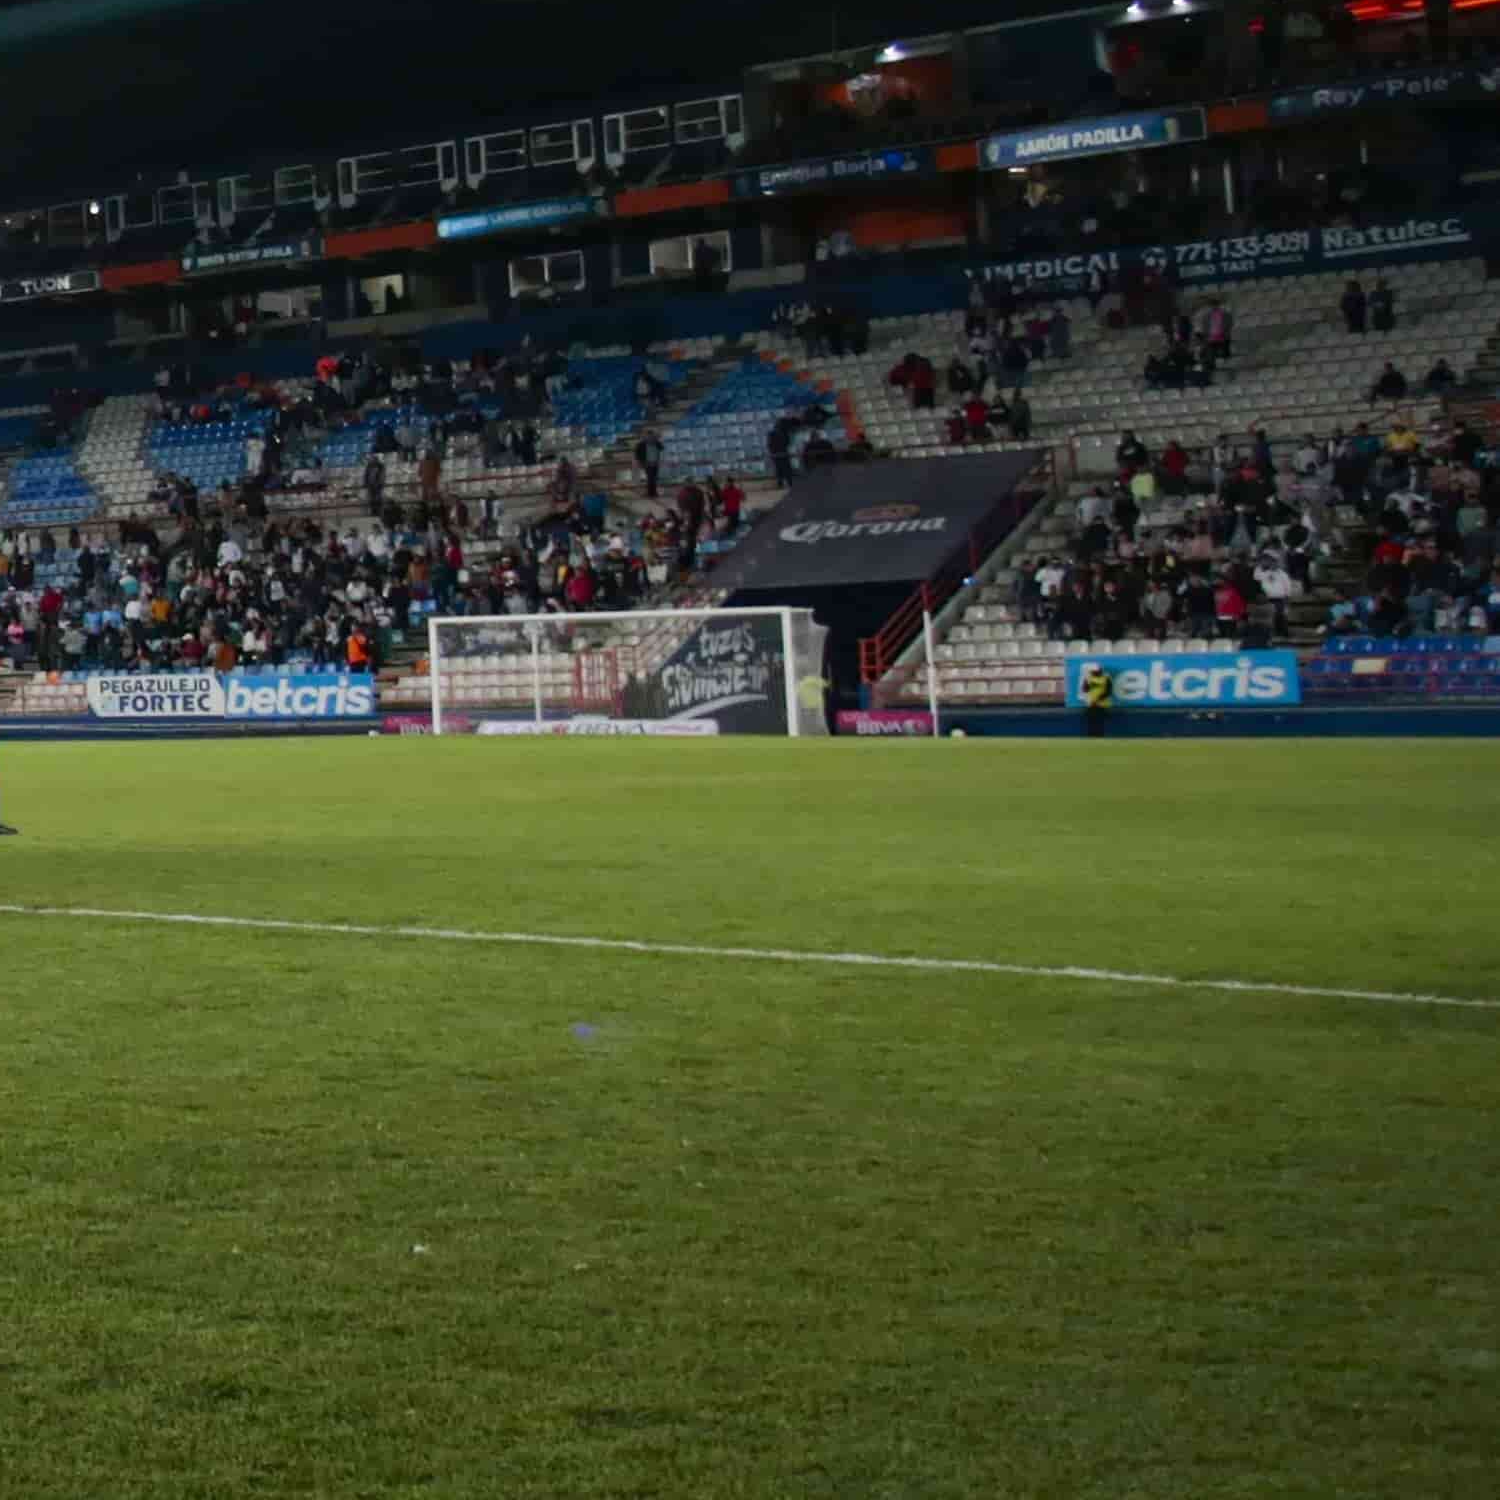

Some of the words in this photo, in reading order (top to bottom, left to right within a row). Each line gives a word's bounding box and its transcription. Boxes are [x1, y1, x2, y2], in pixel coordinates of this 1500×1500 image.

[1072, 124, 1144, 149] PADILLA
[20, 275, 70, 295] TUDN
[779, 517, 948, 544] Corona
[99, 677, 211, 694] PEGAZULEJO
[226, 676, 372, 716] betcris
[118, 693, 212, 713] FORTEC
